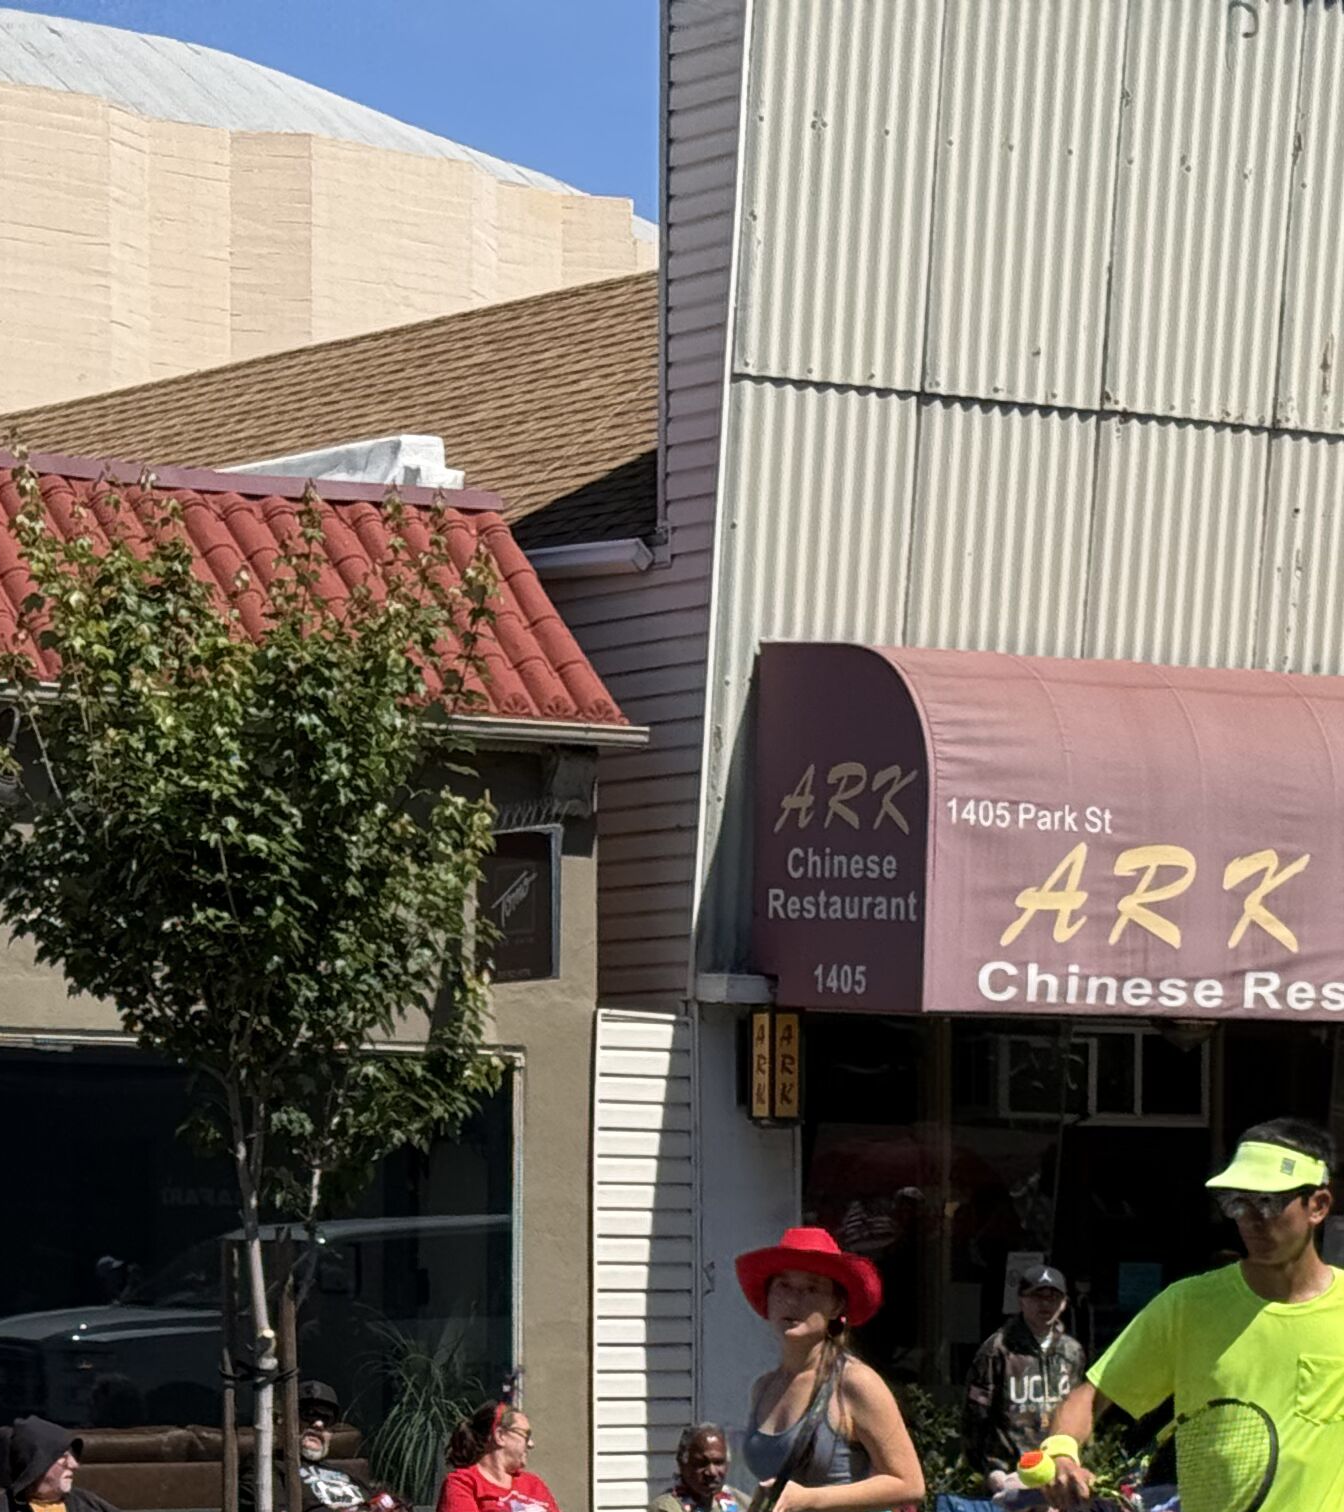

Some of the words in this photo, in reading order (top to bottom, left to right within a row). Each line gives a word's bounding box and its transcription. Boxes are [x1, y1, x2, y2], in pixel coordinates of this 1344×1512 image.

[773, 761, 918, 835] ARK
[946, 798, 1011, 828] 1405
[1017, 803, 1079, 832] Park
[1084, 806, 1113, 834] St
[787, 848, 897, 879] Chinese
[767, 888, 918, 922] Restaurant
[999, 842, 1311, 953] ARK
[814, 964, 867, 995] 1405
[978, 961, 1224, 1008] Chinese
